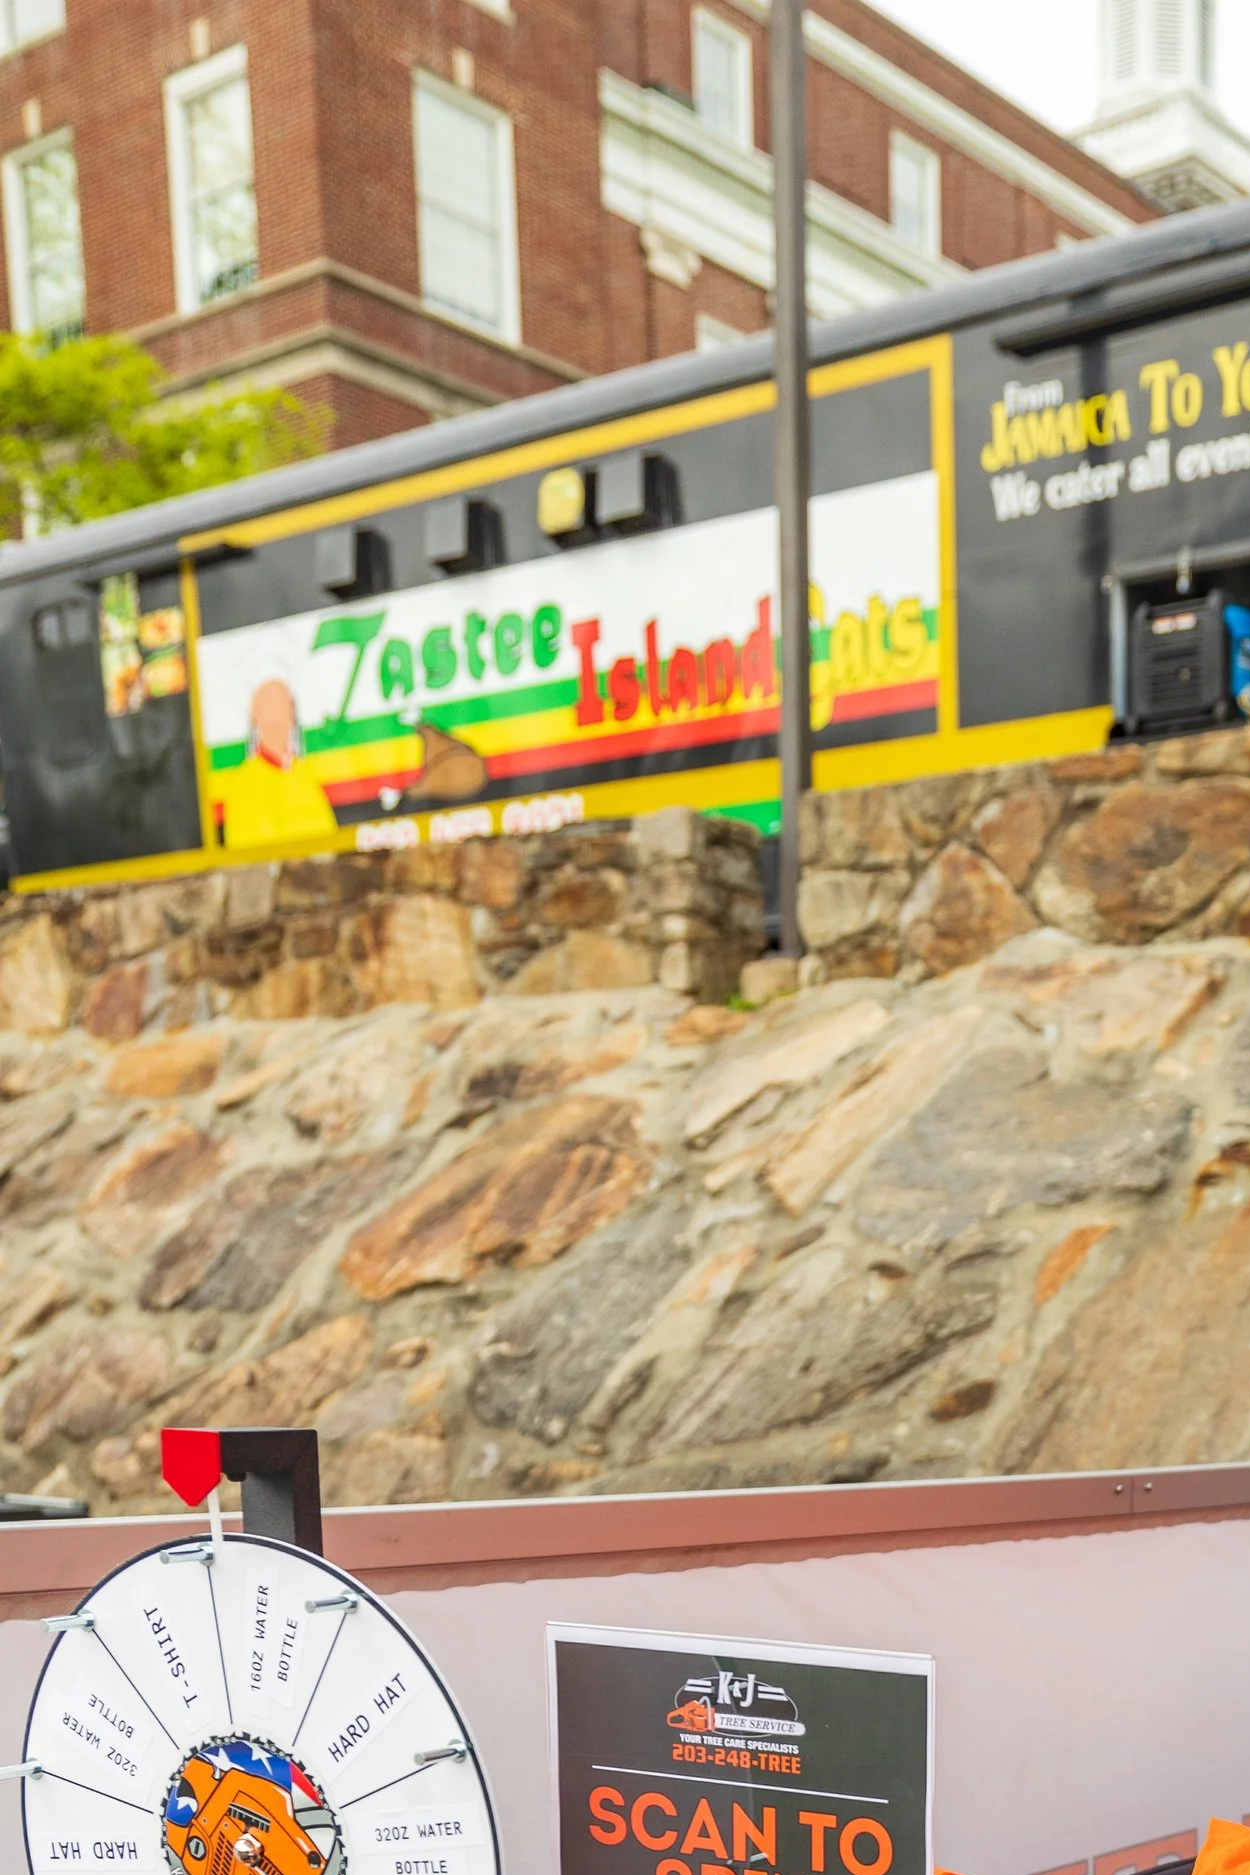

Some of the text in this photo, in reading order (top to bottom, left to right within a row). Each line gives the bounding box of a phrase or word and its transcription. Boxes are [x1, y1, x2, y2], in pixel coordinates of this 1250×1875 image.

[991, 470, 1041, 522] We
[1045, 458, 1125, 511] cater
[1128, 437, 1170, 492] all
[312, 603, 562, 738] Tastee
[571, 595, 775, 728] Island
[254, 1584, 270, 1640] WATER
[143, 1606, 199, 1709] T-SHIRT
[277, 1617, 299, 1683] BOTTLE
[716, 1670, 757, 1708] K&J
[61, 1710, 102, 1750] WATER
[87, 1693, 135, 1740] BOTTLE
[327, 1672, 408, 1763] HARD HAT
[719, 1716, 797, 1734] TREE SERVICE
[671, 1742, 802, 1776] 203-248-TREE
[679, 1732, 800, 1755] YOUR TREE CARE SPECIALISTS
[416, 1821, 464, 1839] WATER
[587, 1785, 777, 1867] SCAN
[50, 1841, 138, 1860] HARD HAT
[395, 1859, 449, 1875] BOTTLE
